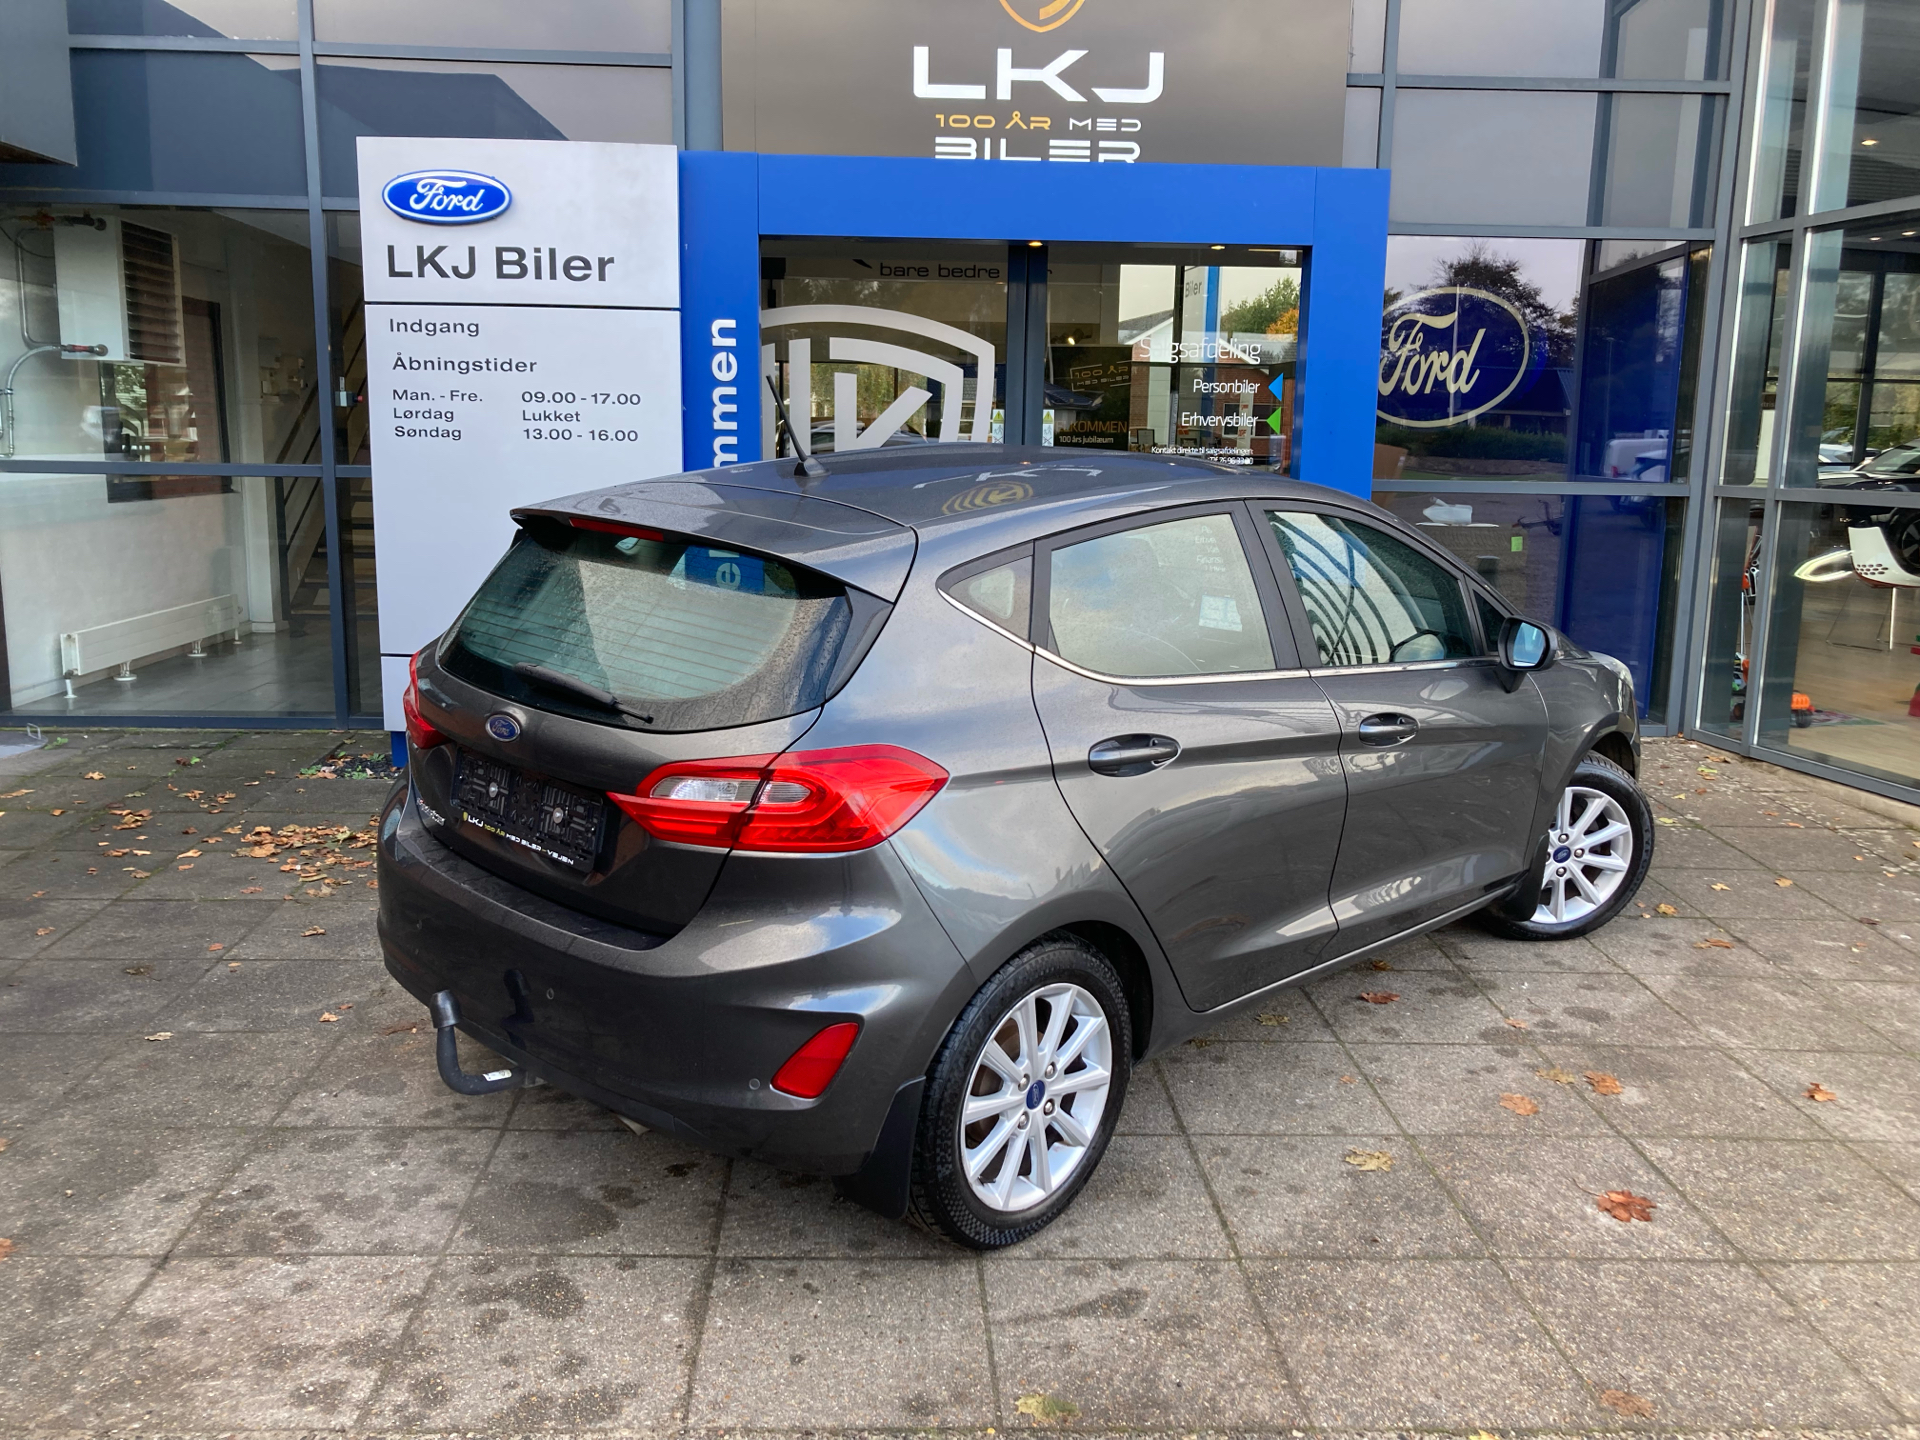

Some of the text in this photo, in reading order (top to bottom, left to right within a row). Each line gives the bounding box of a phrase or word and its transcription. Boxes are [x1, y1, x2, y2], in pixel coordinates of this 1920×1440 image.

[913, 46, 1165, 104] LKJ
[935, 110, 1142, 132] 100 ÅR MED
[934, 136, 1142, 164] BILER
[410, 177, 485, 213] Ford
[386, 244, 615, 282] LKJ Biler
[880, 262, 1000, 280] bare bedre
[389, 318, 480, 338] Indgang
[1378, 313, 1487, 397] Ford
[392, 351, 538, 375] Åbningstider
[1074, 369, 1103, 379] 100
[1193, 379, 1260, 394] Personbiler
[392, 389, 435, 402] Man.
[450, 390, 483, 402] Fre.
[521, 391, 576, 404] 09.00
[591, 393, 641, 406] 17.00
[393, 407, 455, 422] Lørdag
[522, 410, 581, 422] Lukket
[1181, 412, 1259, 427] Erhvervsbiler
[394, 426, 462, 441] Søndag
[523, 428, 573, 441] 13.00
[588, 429, 639, 442] 16.00
[1056, 421, 1128, 434] ELKOMMEN
[1059, 435, 1072, 443] 100
[1082, 435, 1114, 445] jubilæum
[1151, 446, 1177, 454] Kontakt
[1177, 446, 1199, 454] direkte
[467, 814, 484, 828] LKJ
[521, 838, 542, 851] BILER
[547, 849, 574, 865] VEJEN
